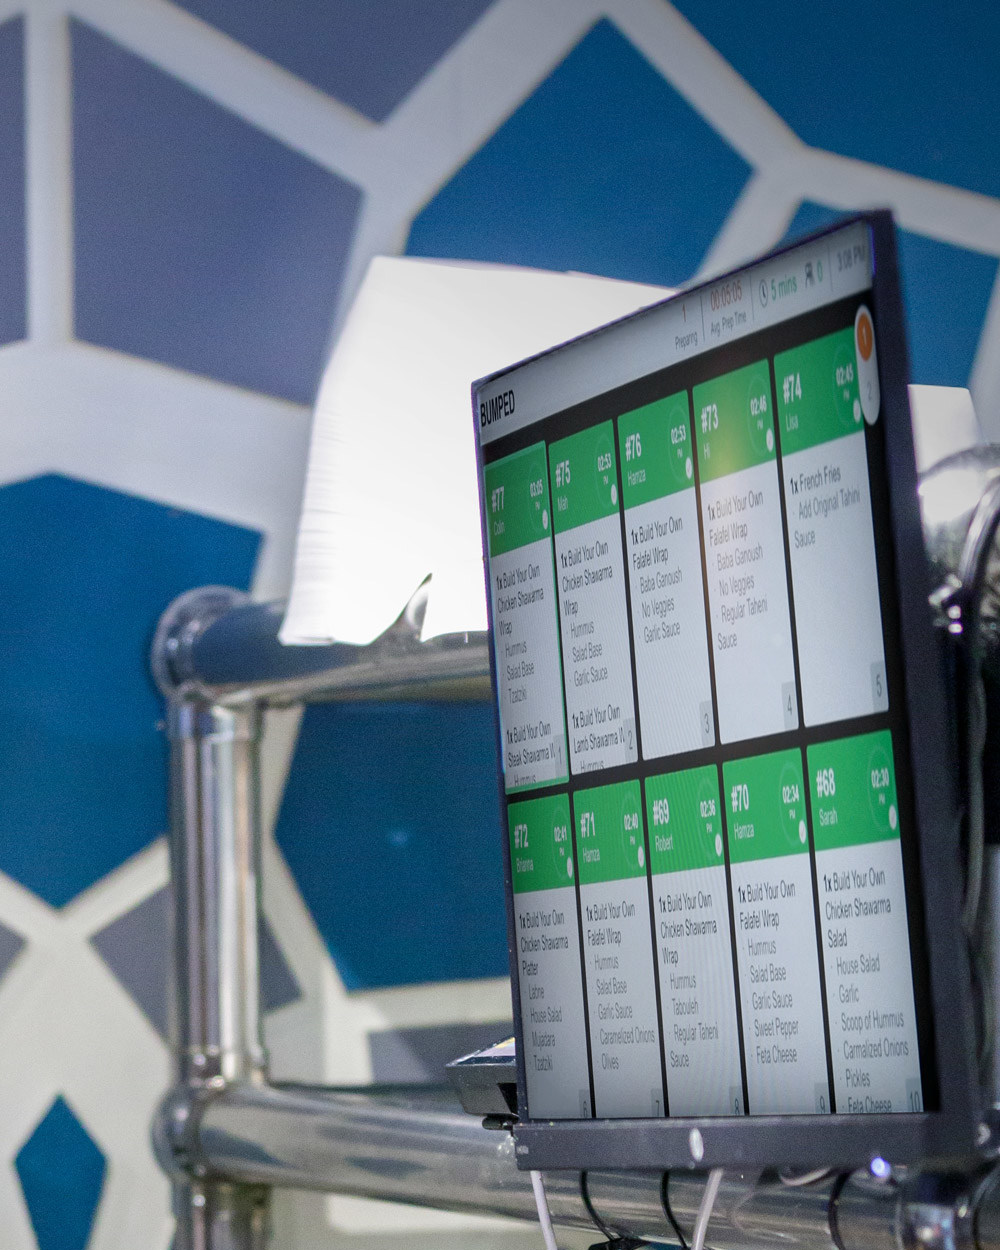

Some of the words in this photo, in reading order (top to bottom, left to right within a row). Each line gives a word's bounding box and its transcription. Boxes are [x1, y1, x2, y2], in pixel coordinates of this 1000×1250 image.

[710, 280, 742, 312] 00:05:05
[778, 277, 797, 296] mins
[722, 313, 734, 330] Prep
[734, 311, 746, 324] Time
[675, 331, 698, 350] Preparing
[783, 372, 802, 405] #74
[480, 390, 515, 427] BUMPED
[701, 404, 719, 433] #73
[671, 425, 686, 444] 02:53
[625, 433, 641, 461] #76
[556, 460, 570, 488] #75
[791, 478, 798, 495] 1x
[800, 470, 823, 492] French
[824, 465, 841, 486] Fries
[708, 505, 715, 520] 1x
[716, 500, 732, 517] Build
[733, 495, 747, 513] Your
[749, 491, 763, 508] Own
[799, 500, 812, 520] Add
[813, 492, 839, 518] Original
[631, 530, 639, 545] 1x
[639, 526, 654, 543] Build
[654, 521, 668, 538] Your
[669, 517, 683, 533] Own
[710, 527, 730, 547] Falafel
[731, 523, 748, 541] Wrap
[795, 530, 815, 548] Sauce
[561, 554, 568, 568] 1x
[568, 549, 581, 565] Build
[582, 545, 595, 561] Your
[596, 541, 608, 558] Own
[633, 551, 651, 570] Falafel
[652, 548, 668, 565] Wrap
[717, 550, 734, 571] Baba
[735, 543, 763, 565] Ganoush
[562, 573, 584, 592] Chicken
[584, 566, 612, 586] Shawarma
[640, 574, 655, 594] Baba
[656, 567, 683, 588] Ganoush
[719, 580, 728, 597] No
[729, 574, 755, 595] Veggies
[564, 600, 578, 617] Wrap
[642, 602, 650, 619] No
[651, 595, 675, 618] Veggies
[721, 602, 745, 625] Regular
[571, 621, 594, 638] Hummus
[644, 625, 660, 643] Garlic
[662, 621, 680, 638] Sauce
[573, 642, 588, 662] Salad
[588, 642, 602, 659] Base
[718, 633, 737, 650] Sauce
[574, 668, 590, 687] Garlic
[591, 666, 608, 683] Sauce
[572, 714, 579, 728] 1x
[580, 709, 594, 728] Build
[594, 707, 606, 724] Your
[608, 704, 620, 721] Own
[574, 734, 589, 754] Lamb
[590, 731, 619, 750] Shawarma
[816, 768, 836, 798] #68
[731, 784, 749, 812] #70
[782, 785, 799, 804] 02:34
[653, 798, 670, 826] #69
[819, 806, 838, 826] Sarah
[581, 812, 595, 838] #71
[734, 823, 754, 840] Hamza
[514, 824, 528, 848] #72
[655, 835, 673, 852] Robert
[824, 874, 832, 892] 1x
[833, 871, 850, 891] Build
[851, 870, 867, 889] Your
[869, 867, 886, 887] Own
[659, 896, 666, 913] 1x
[667, 894, 682, 912] Build
[683, 893, 697, 910] Your
[698, 891, 712, 909] Own
[738, 886, 746, 903] 1x
[747, 883, 763, 902] Build
[763, 882, 779, 900] Your
[779, 880, 795, 898] Own
[586, 905, 593, 922] 1x
[594, 903, 608, 921] Build
[608, 902, 621, 919] Your
[622, 901, 635, 917] Own
[825, 900, 853, 920] Chicken
[854, 898, 891, 917] Shawarma
[661, 921, 684, 939] Chicken
[685, 919, 717, 937] Shawarma
[740, 911, 761, 930] Falafel
[762, 910, 779, 931] Wrap
[521, 936, 541, 953] Chicken
[542, 935, 568, 951] Shawarma
[588, 929, 605, 946] Falafel
[606, 928, 621, 947] Wrap
[748, 938, 776, 956] Hummus
[827, 928, 847, 948] Salad
[522, 960, 538, 976] Platter
[595, 954, 619, 970] Hummus
[662, 948, 678, 967] Wrap
[836, 956, 859, 976] House
[860, 953, 880, 973] Salad
[670, 974, 696, 990] Hummus
[750, 964, 768, 983] Salad
[769, 964, 786, 982] Base
[597, 978, 611, 995] Salad
[613, 977, 627, 994] Base
[839, 984, 859, 1004] Garlic
[672, 998, 698, 1015] Tabouleh
[752, 992, 772, 1010] Garlic
[772, 990, 792, 1009] Sauce
[598, 1003, 614, 1020] Garlic
[615, 1002, 632, 1019] Sauce
[755, 1019, 774, 1037] Sweet
[776, 1017, 799, 1040] Pepper
[841, 1013, 863, 1034] Scoop
[864, 1010, 871, 1030] of
[873, 1010, 904, 1029] Hummus
[601, 1028, 634, 1045] Caramelized
[635, 1026, 655, 1043] Onions
[674, 1023, 697, 1046] Regular
[671, 1050, 689, 1067] Sauce
[756, 1045, 771, 1064] Feta
[773, 1045, 797, 1063] Cheese
[844, 1040, 882, 1059] Carmalized
[883, 1038, 909, 1057] Onions
[602, 1053, 619, 1070] Olives
[846, 1069, 871, 1088] Pickles
[848, 1097, 864, 1113] Feta
[865, 1096, 892, 1113] Cheese
[910, 1091, 920, 1112] 10
